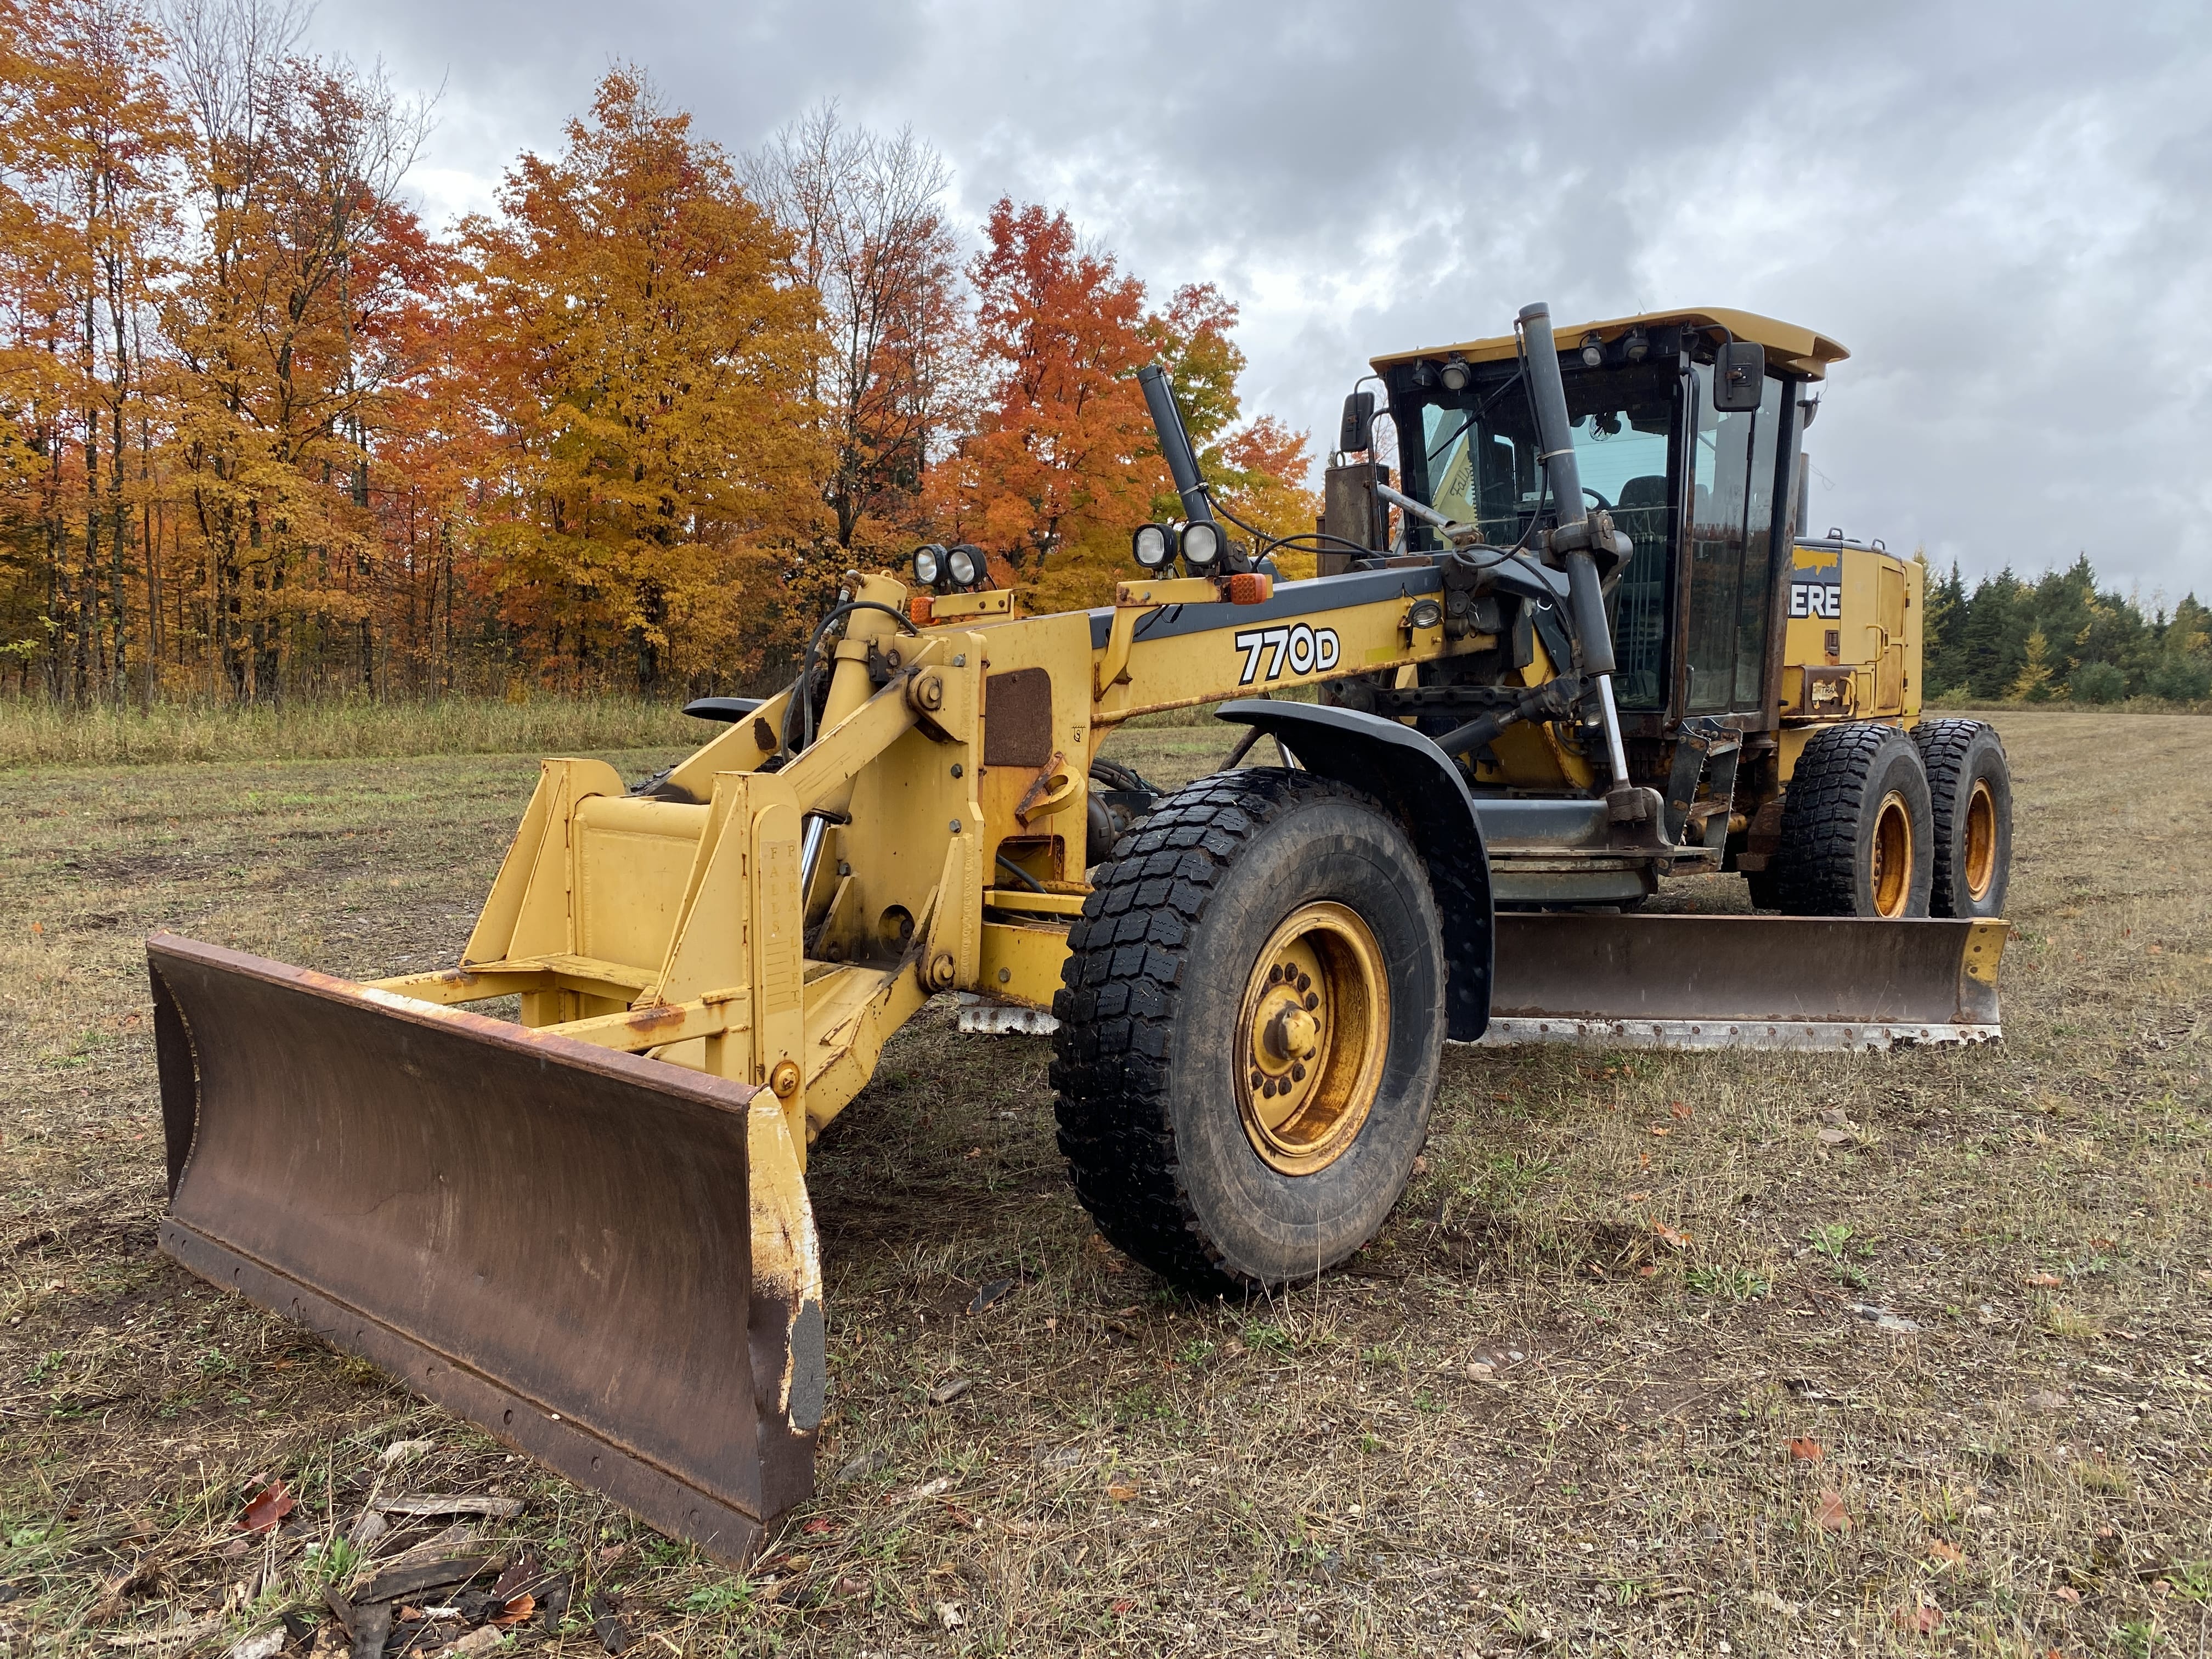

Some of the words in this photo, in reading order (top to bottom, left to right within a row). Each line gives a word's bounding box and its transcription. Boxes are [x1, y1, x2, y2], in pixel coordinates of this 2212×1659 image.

[1788, 581, 1841, 619] ERE
[1234, 622, 1340, 686] 770D
[770, 847, 780, 933] FALLS
